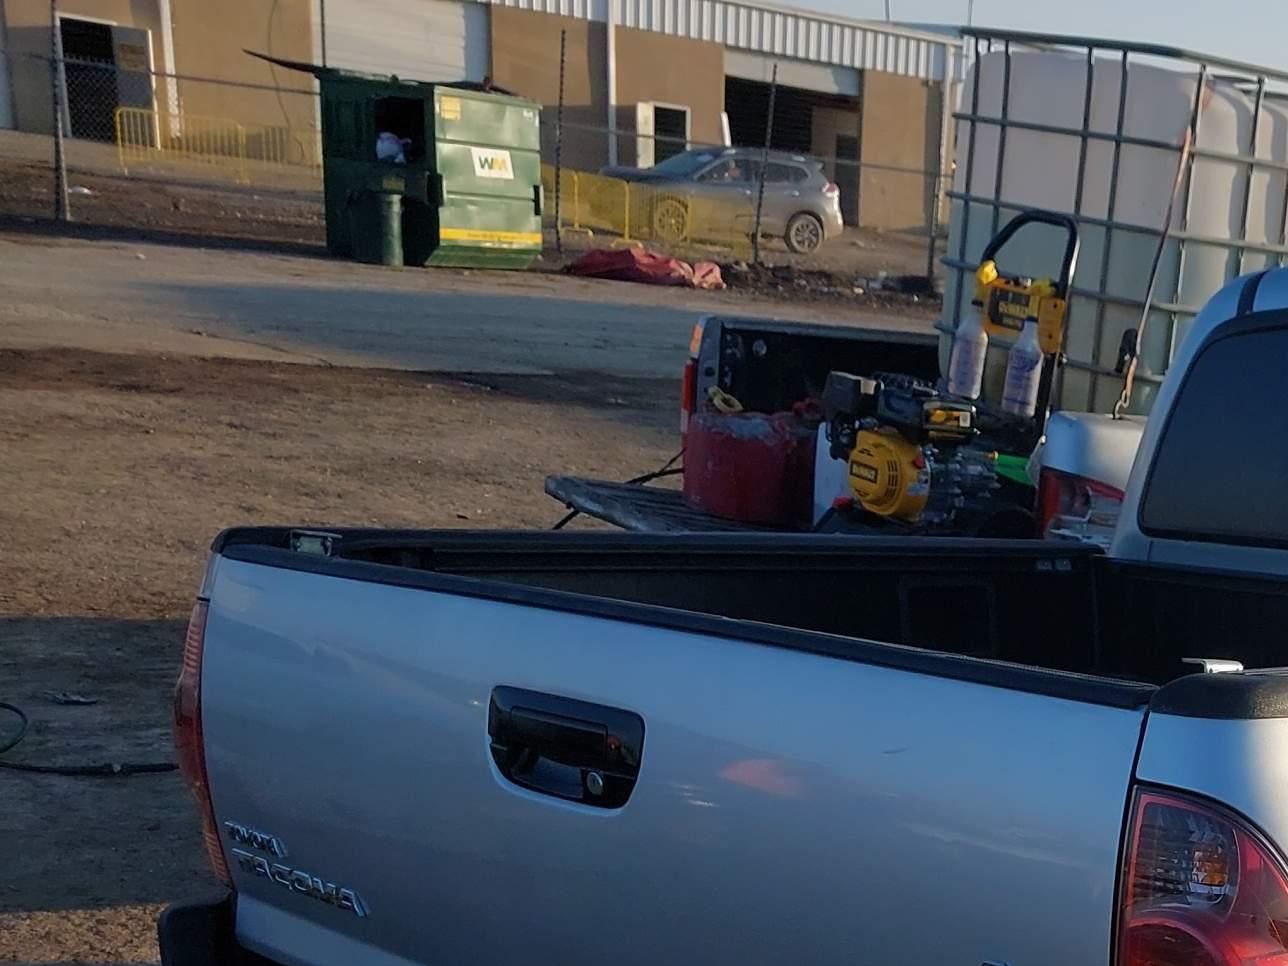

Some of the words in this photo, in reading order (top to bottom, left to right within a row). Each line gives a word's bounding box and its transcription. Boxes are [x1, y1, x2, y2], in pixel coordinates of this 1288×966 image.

[478, 155, 509, 172] WM
[223, 819, 288, 859] TOYOTA
[231, 846, 370, 919] TACOMA
